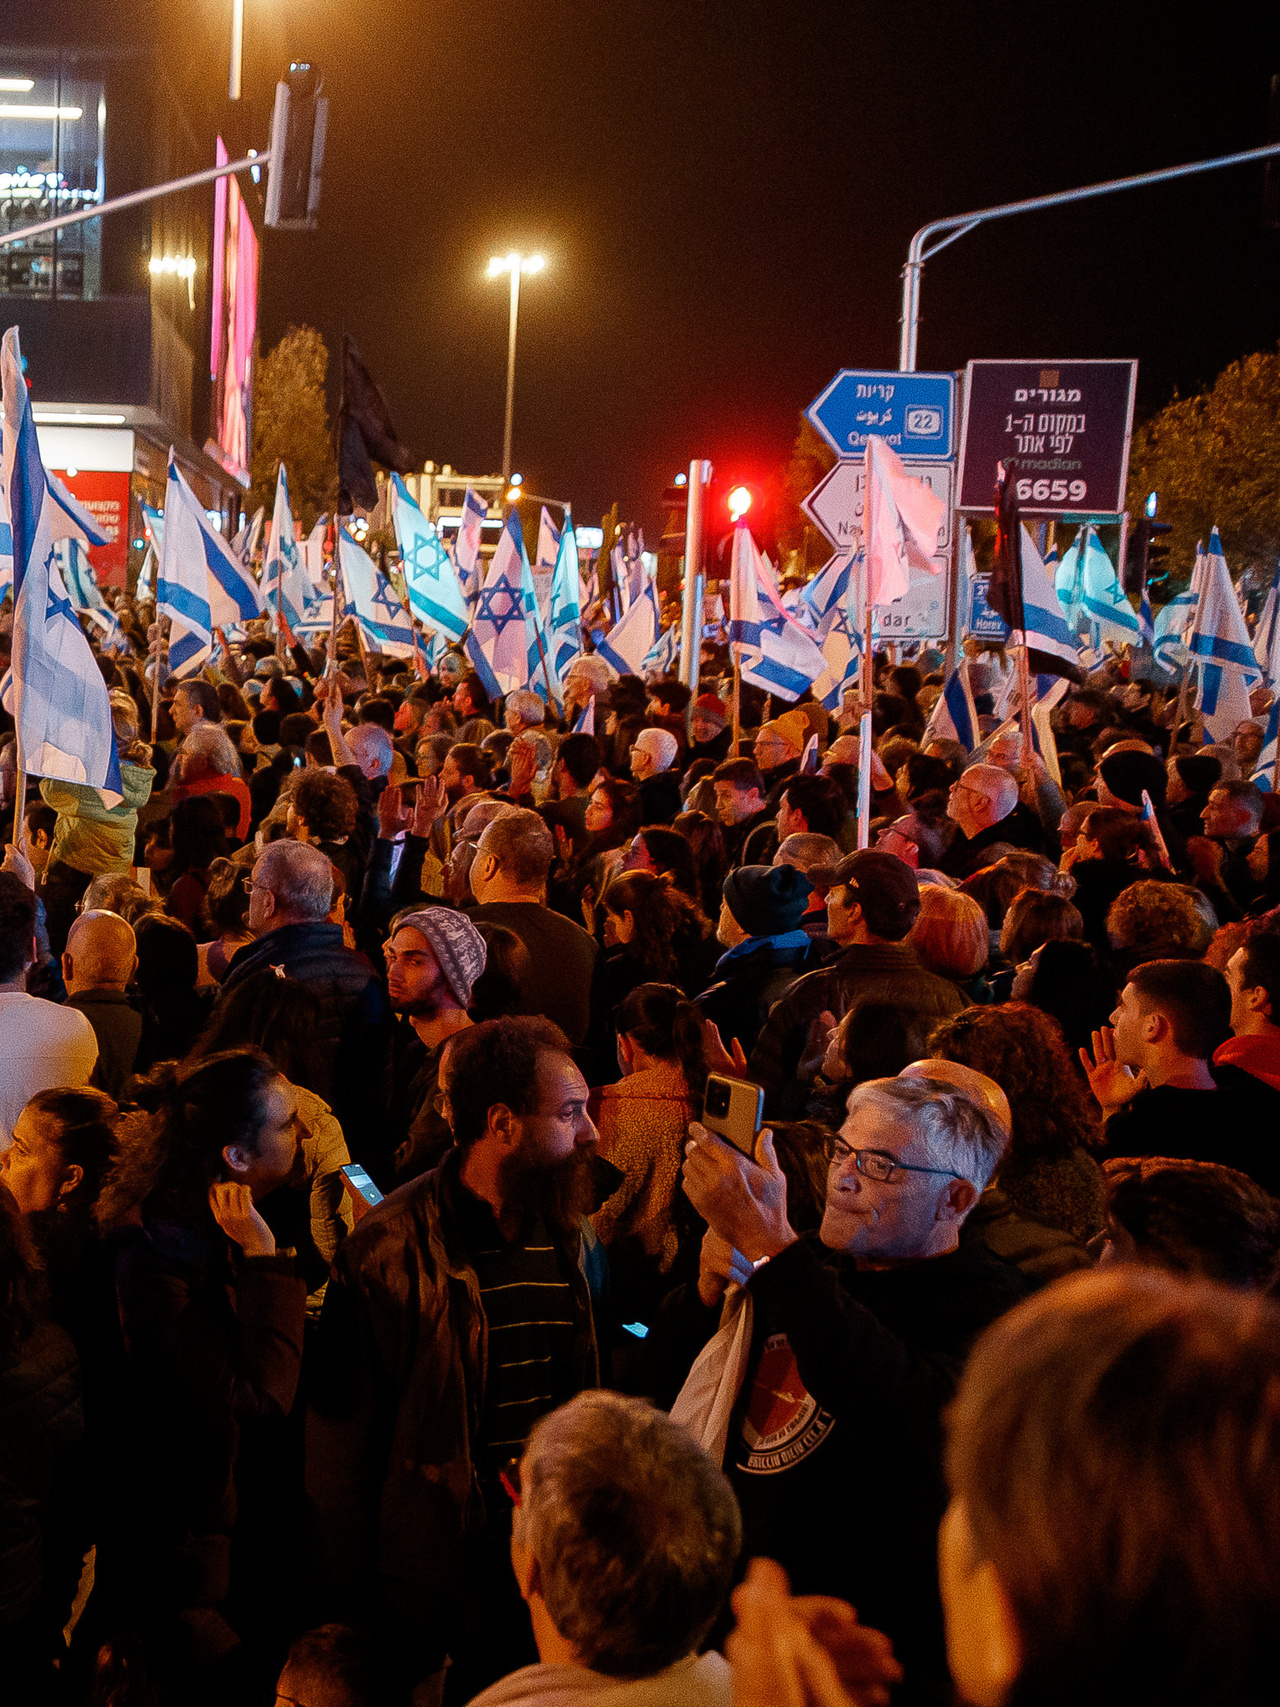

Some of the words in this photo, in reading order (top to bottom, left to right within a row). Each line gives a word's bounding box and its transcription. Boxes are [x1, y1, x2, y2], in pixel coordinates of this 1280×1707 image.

[856, 384, 895, 403] קריות
[1014, 388, 1082, 402] מגורים
[914, 413, 933, 429] 22
[1037, 413, 1086, 436] במקום
[1014, 434, 1046, 453] אתר
[1049, 432, 1074, 454] לפי
